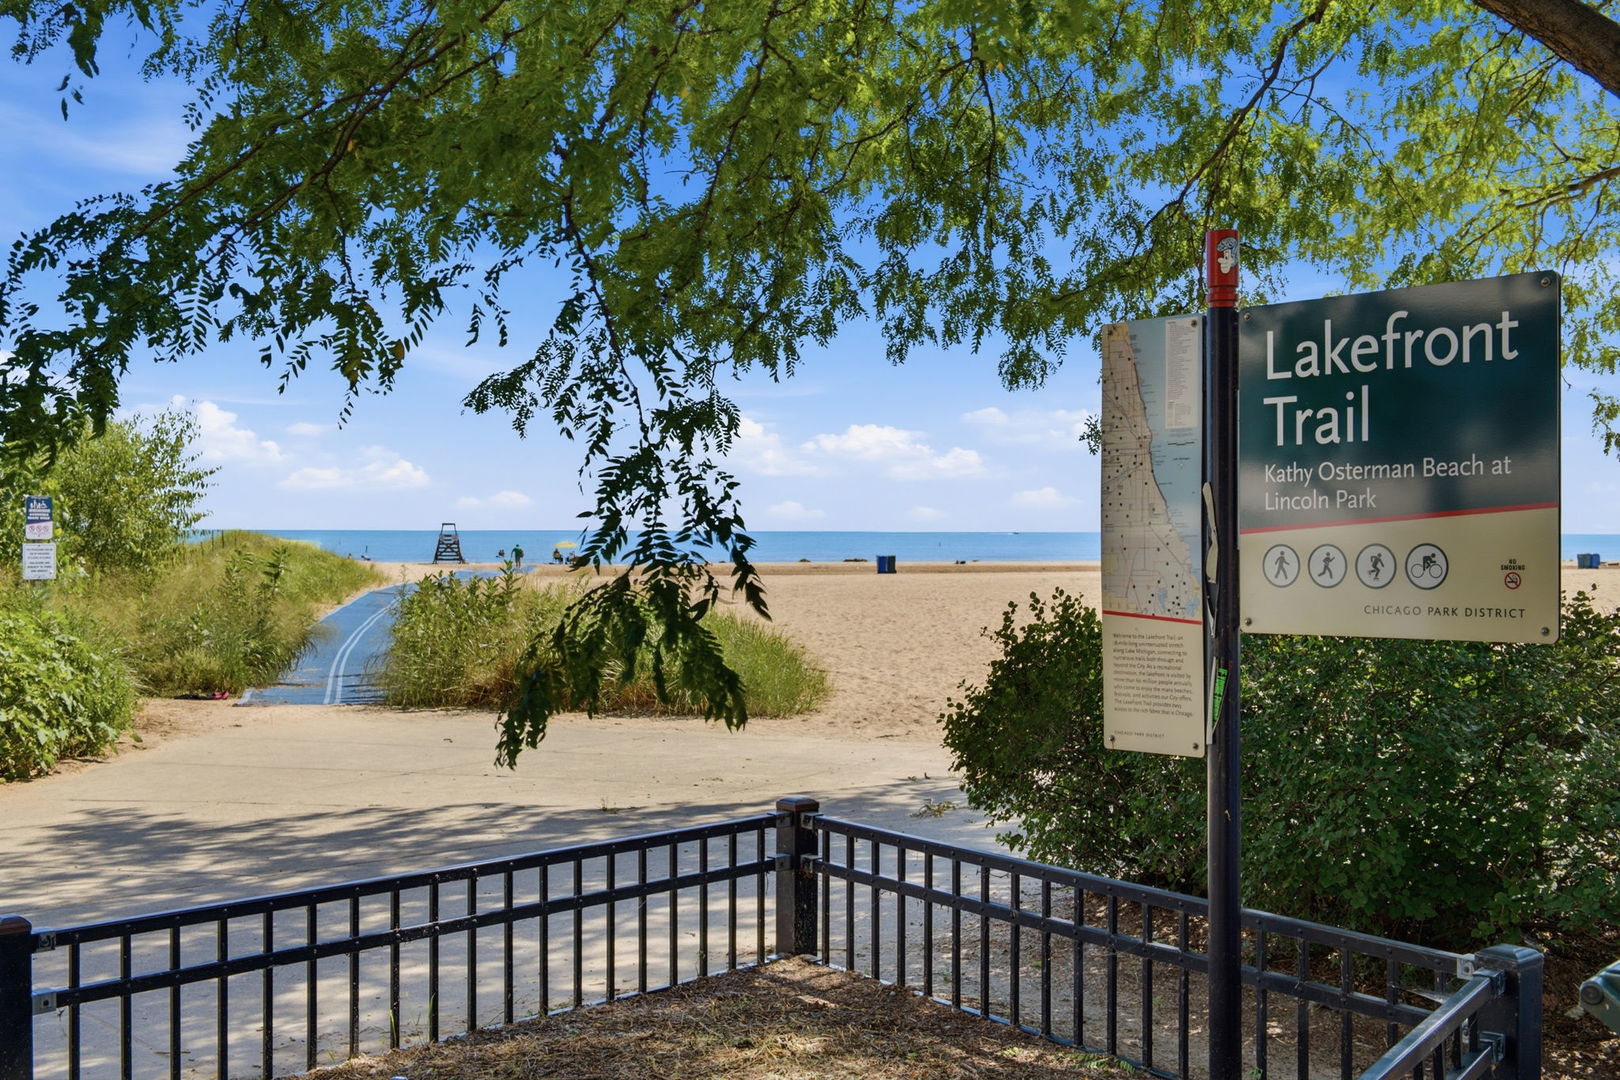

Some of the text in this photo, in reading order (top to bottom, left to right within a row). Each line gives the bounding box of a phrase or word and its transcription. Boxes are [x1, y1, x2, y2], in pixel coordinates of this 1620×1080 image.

[1266, 311, 1519, 380] Lakefront
[1264, 385, 1369, 446] Trail
[1265, 454, 1511, 487] Kathy Osterman Beach at
[1265, 488, 1376, 510] Lincoln Park
[1364, 605, 1525, 619] CHICAGO PARK DISTRICT
